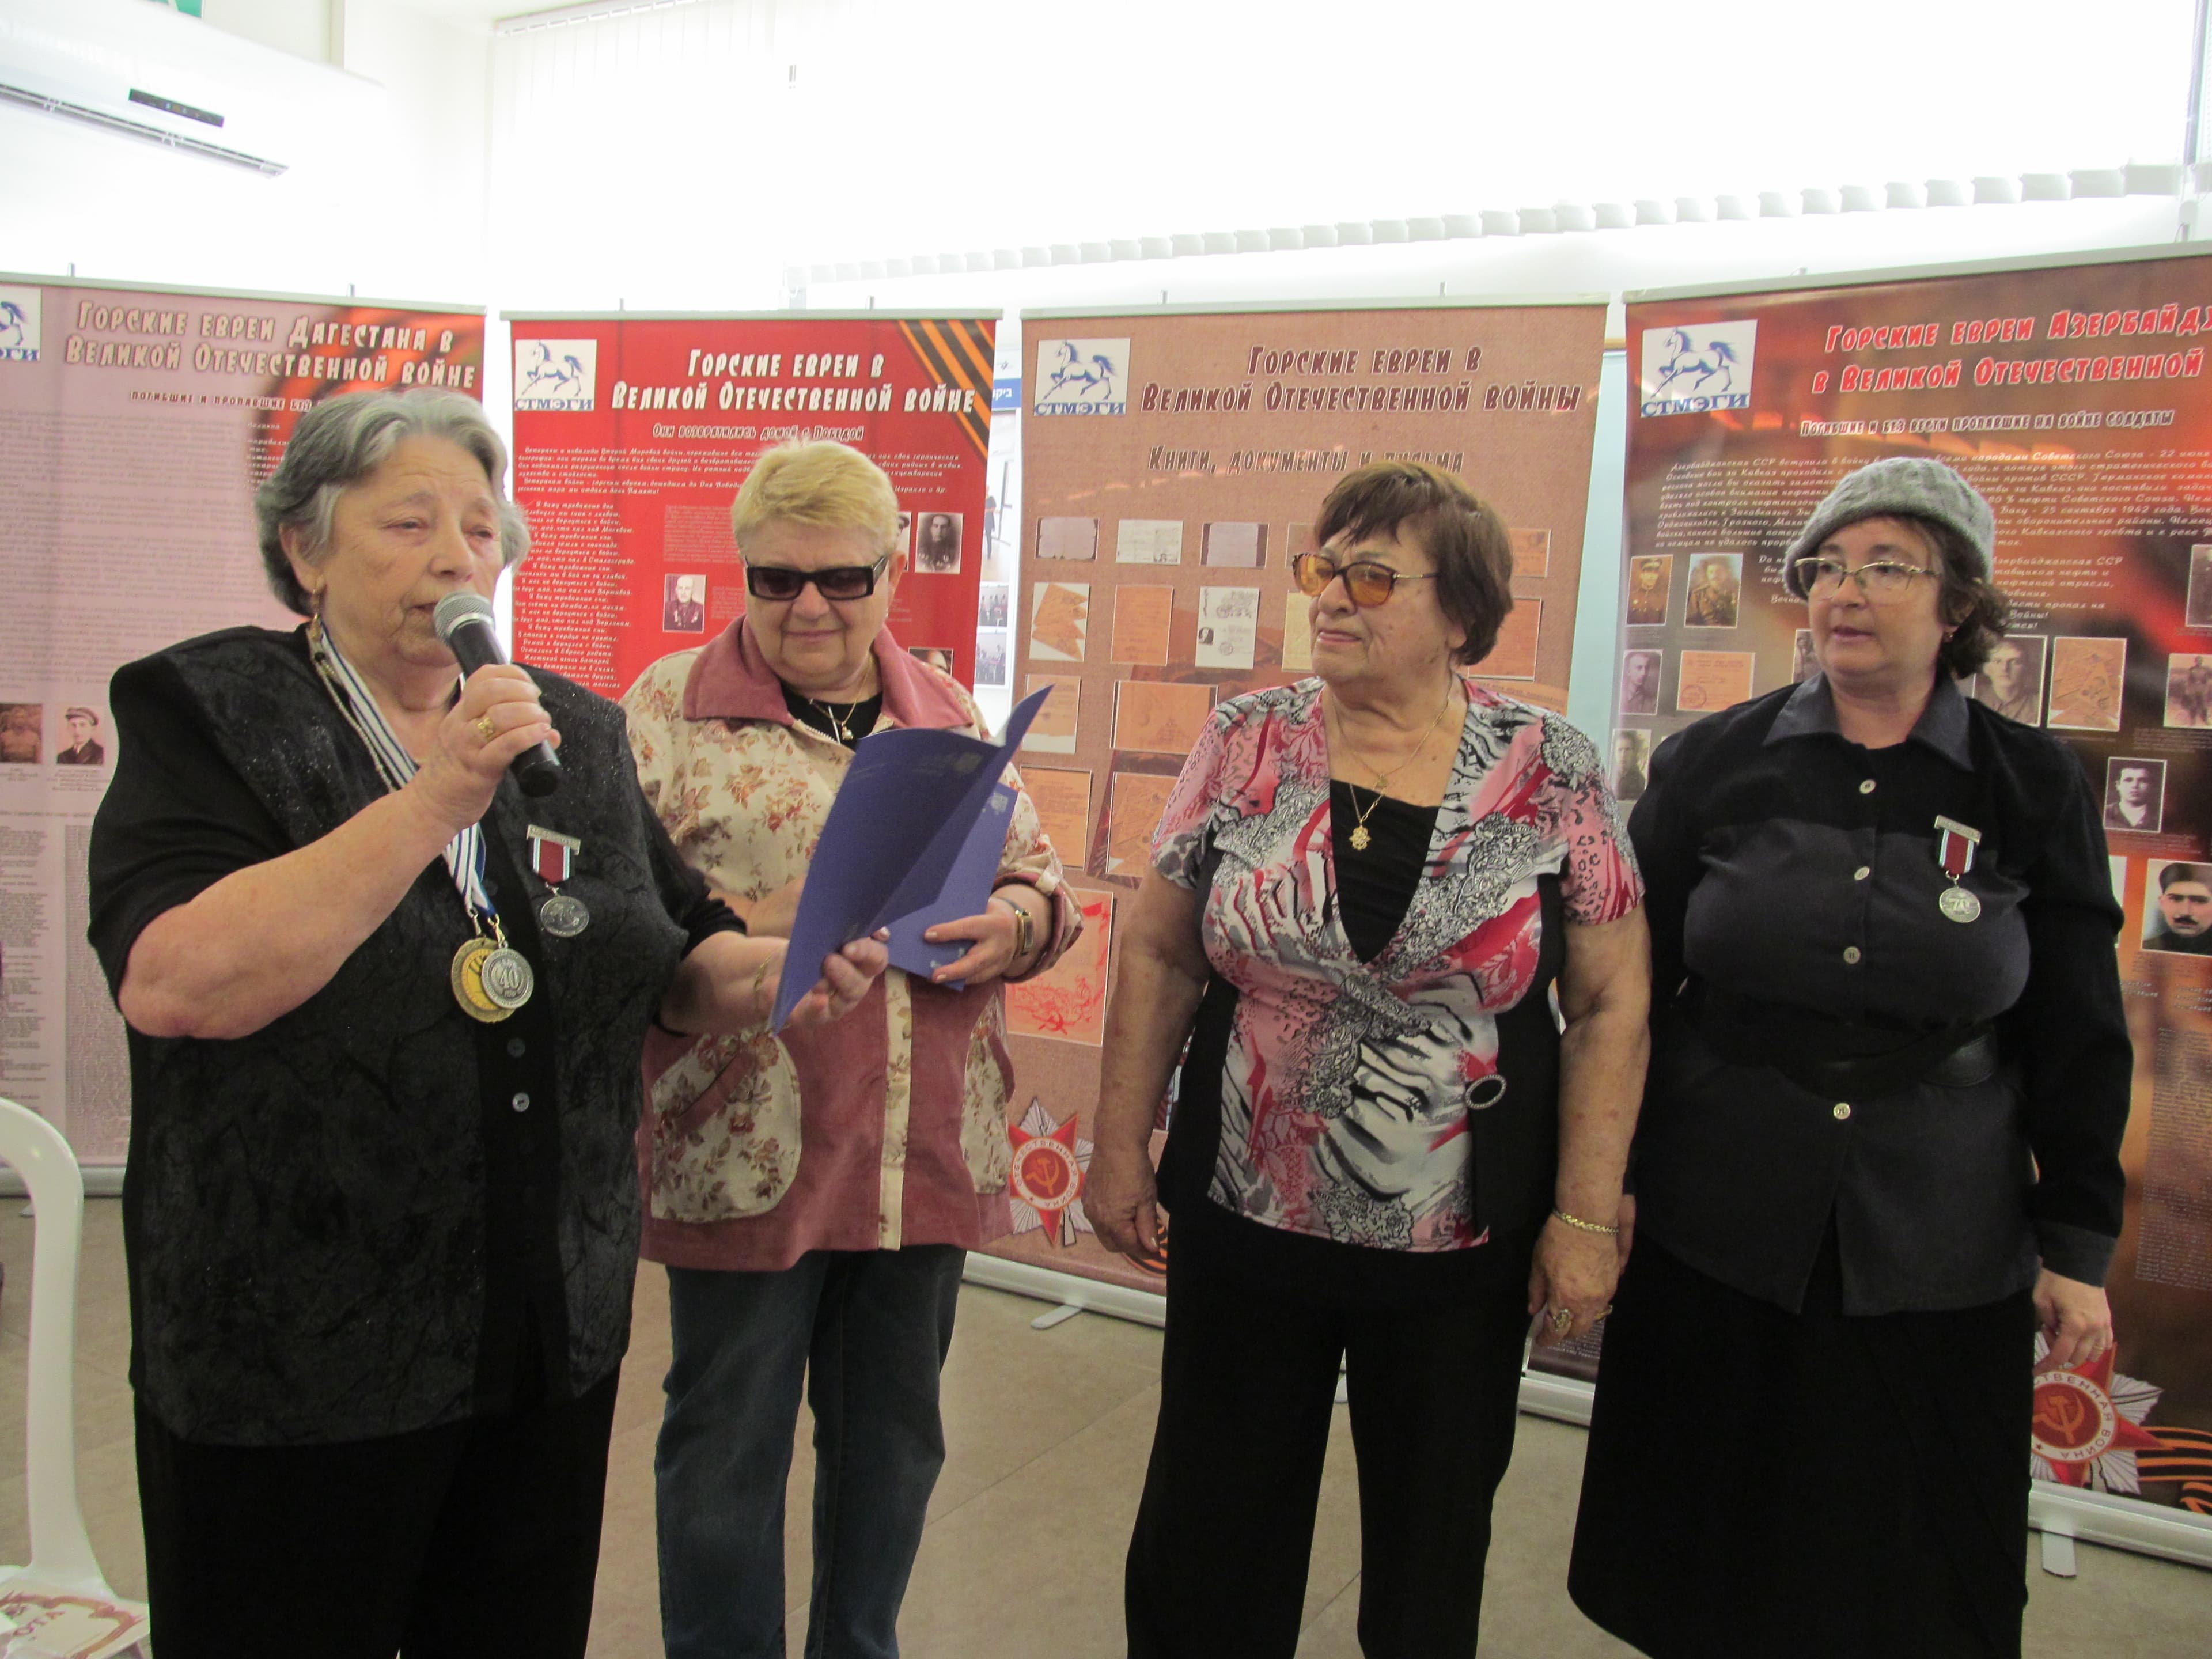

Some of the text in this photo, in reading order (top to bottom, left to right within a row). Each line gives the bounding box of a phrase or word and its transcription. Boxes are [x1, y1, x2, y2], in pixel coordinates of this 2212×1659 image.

[514, 398, 593, 411] СТМЭГИ
[1034, 403, 1126, 415] СТМЭГИ
[1642, 394, 1749, 417] СТМЭГИ
[1995, 566, 2055, 577] тавщиком
